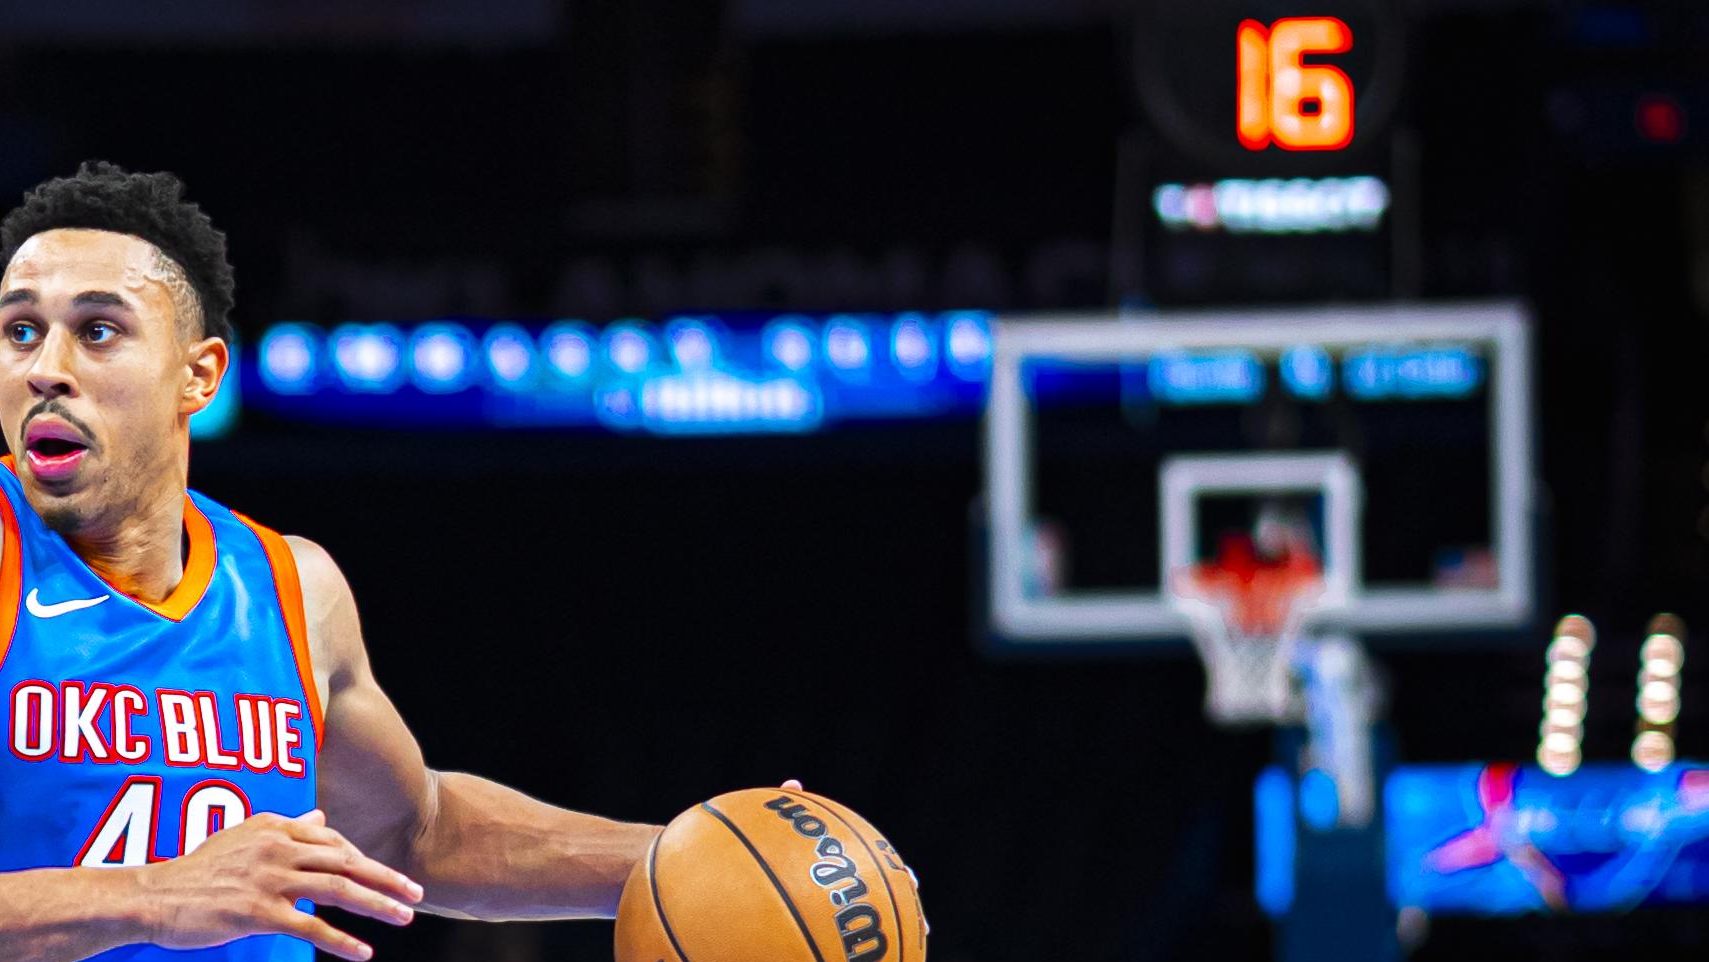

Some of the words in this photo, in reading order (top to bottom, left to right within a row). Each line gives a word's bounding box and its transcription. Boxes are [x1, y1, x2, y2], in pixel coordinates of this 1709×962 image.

[1236, 16, 1355, 151] 16
[10, 680, 151, 764] OKC
[156, 688, 305, 778] BLUE
